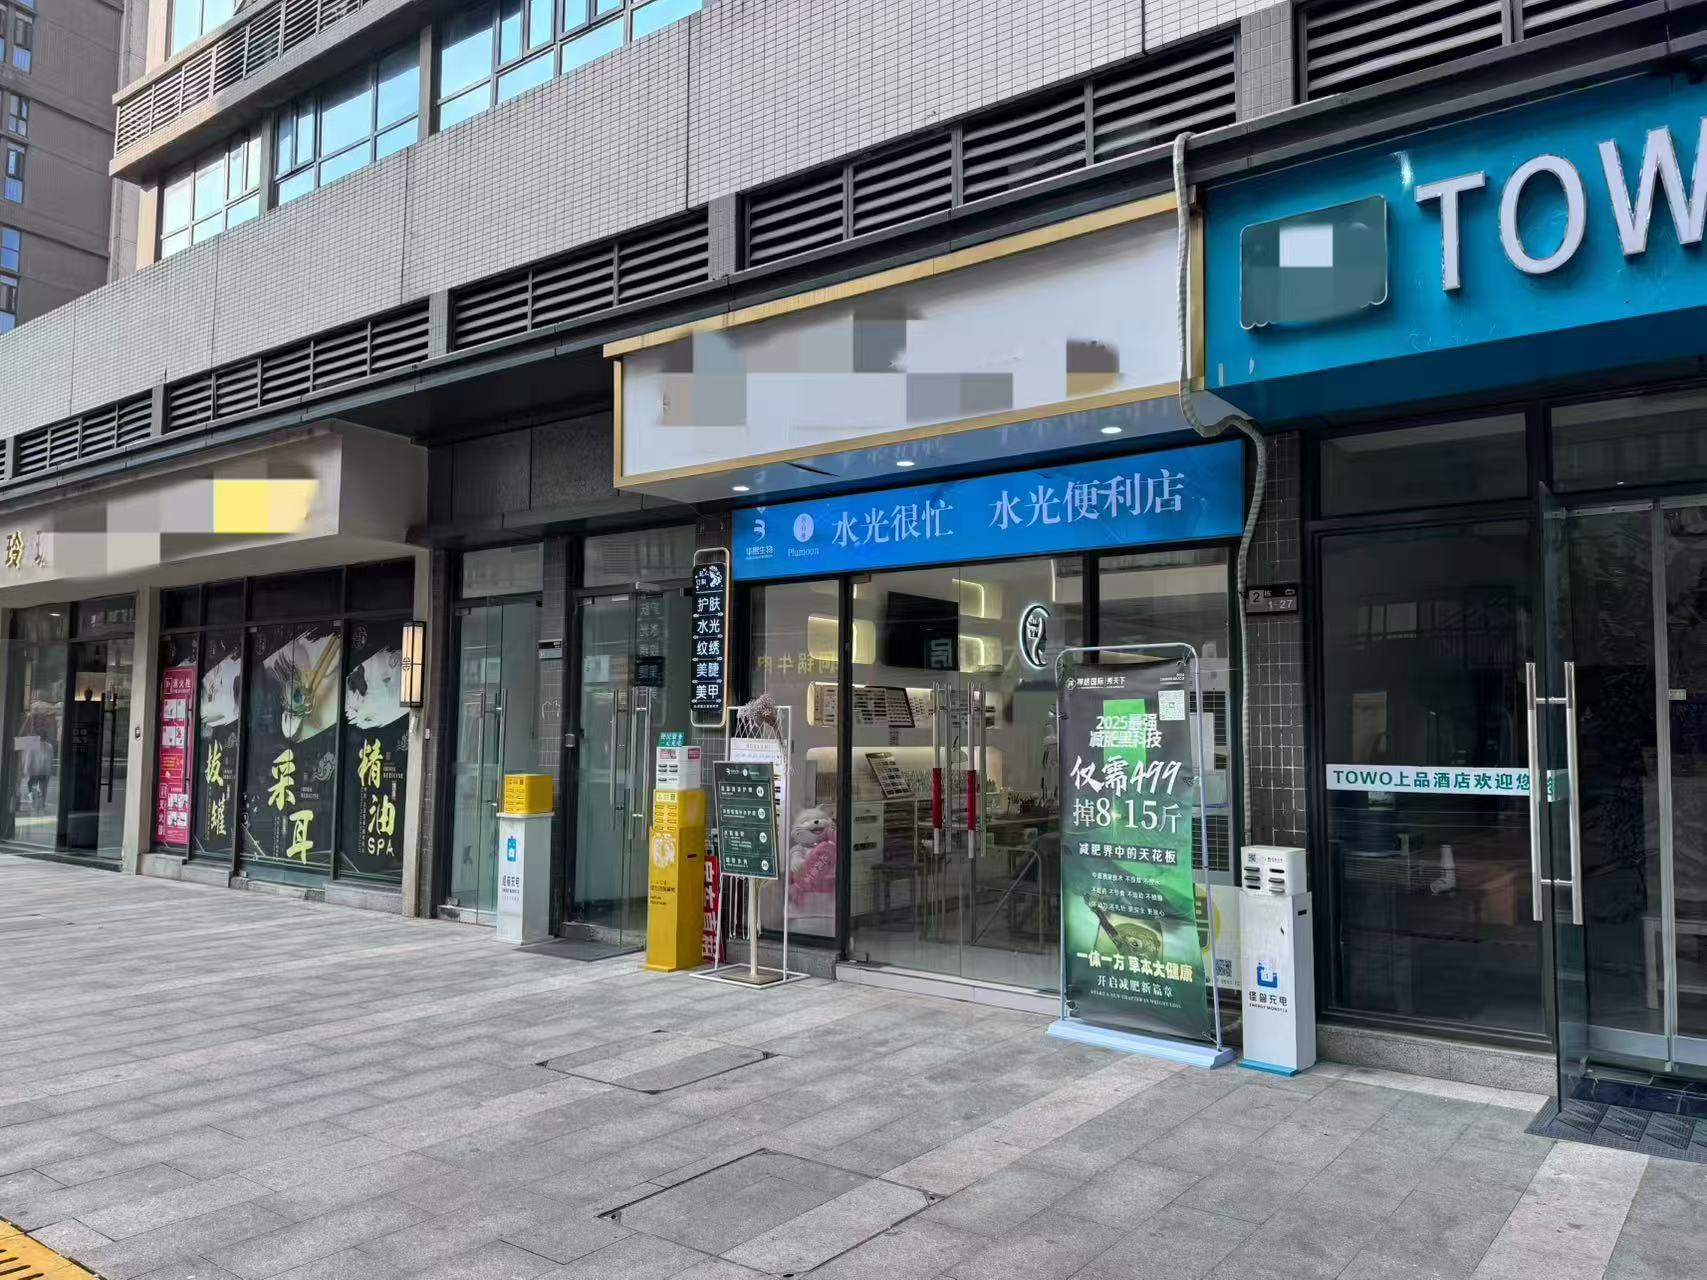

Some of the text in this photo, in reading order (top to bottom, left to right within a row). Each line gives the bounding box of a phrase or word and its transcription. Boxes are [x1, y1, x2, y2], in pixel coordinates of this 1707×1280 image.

[1415, 118, 1707, 294] TOW
[831, 499, 954, 548] 水光很忙
[988, 468, 1186, 531] 水光便利店
[697, 596, 721, 612] 护肤
[1269, 599, 1293, 609] 1-27
[697, 618, 721, 634] 水光
[696, 640, 720, 656] 纹绣
[696, 662, 720, 678] 美睫
[695, 684, 719, 700] 美甲
[1095, 713, 1158, 730] 2025最强
[1088, 729, 1163, 749] 减肥黑科技
[1069, 755, 1182, 797] 仅需499
[358, 738, 396, 836] 精油
[267, 748, 315, 865] 采耳
[367, 837, 395, 857] SPA
[1079, 842, 1177, 864] 减肥界中的天花板
[1127, 955, 1193, 983] 草本大健康
